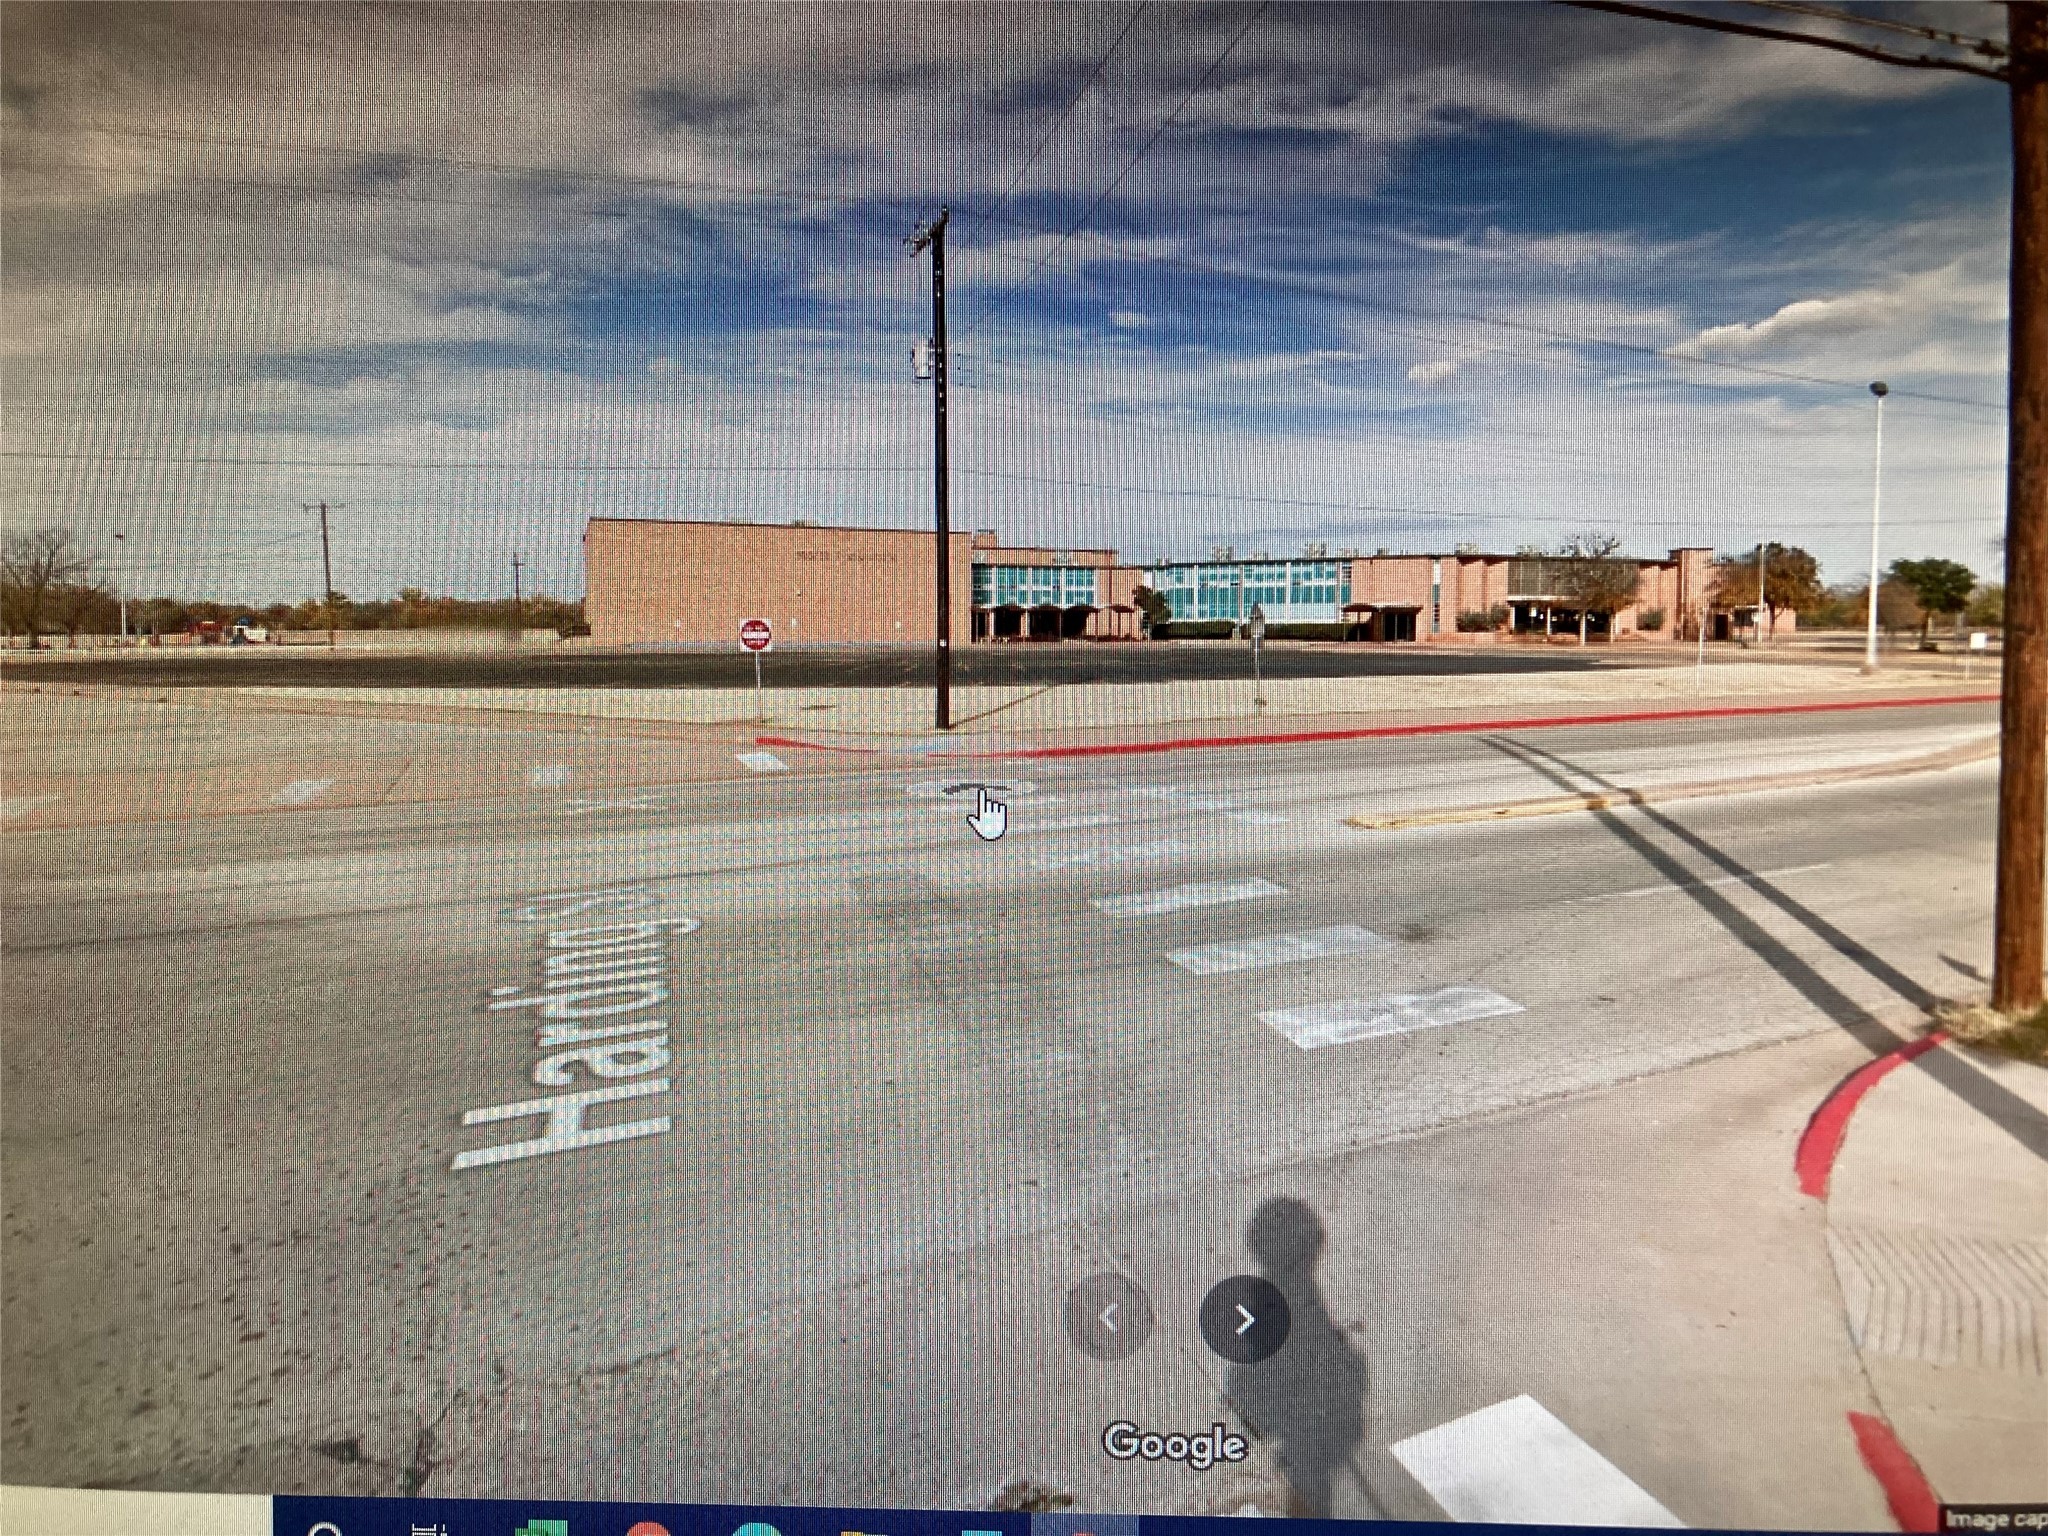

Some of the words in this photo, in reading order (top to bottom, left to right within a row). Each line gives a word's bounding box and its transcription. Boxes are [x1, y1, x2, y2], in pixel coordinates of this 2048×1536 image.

[452, 919, 702, 1169] Harding
[1103, 1420, 1248, 1470] Google
[1945, 1510, 2010, 1531] Image
